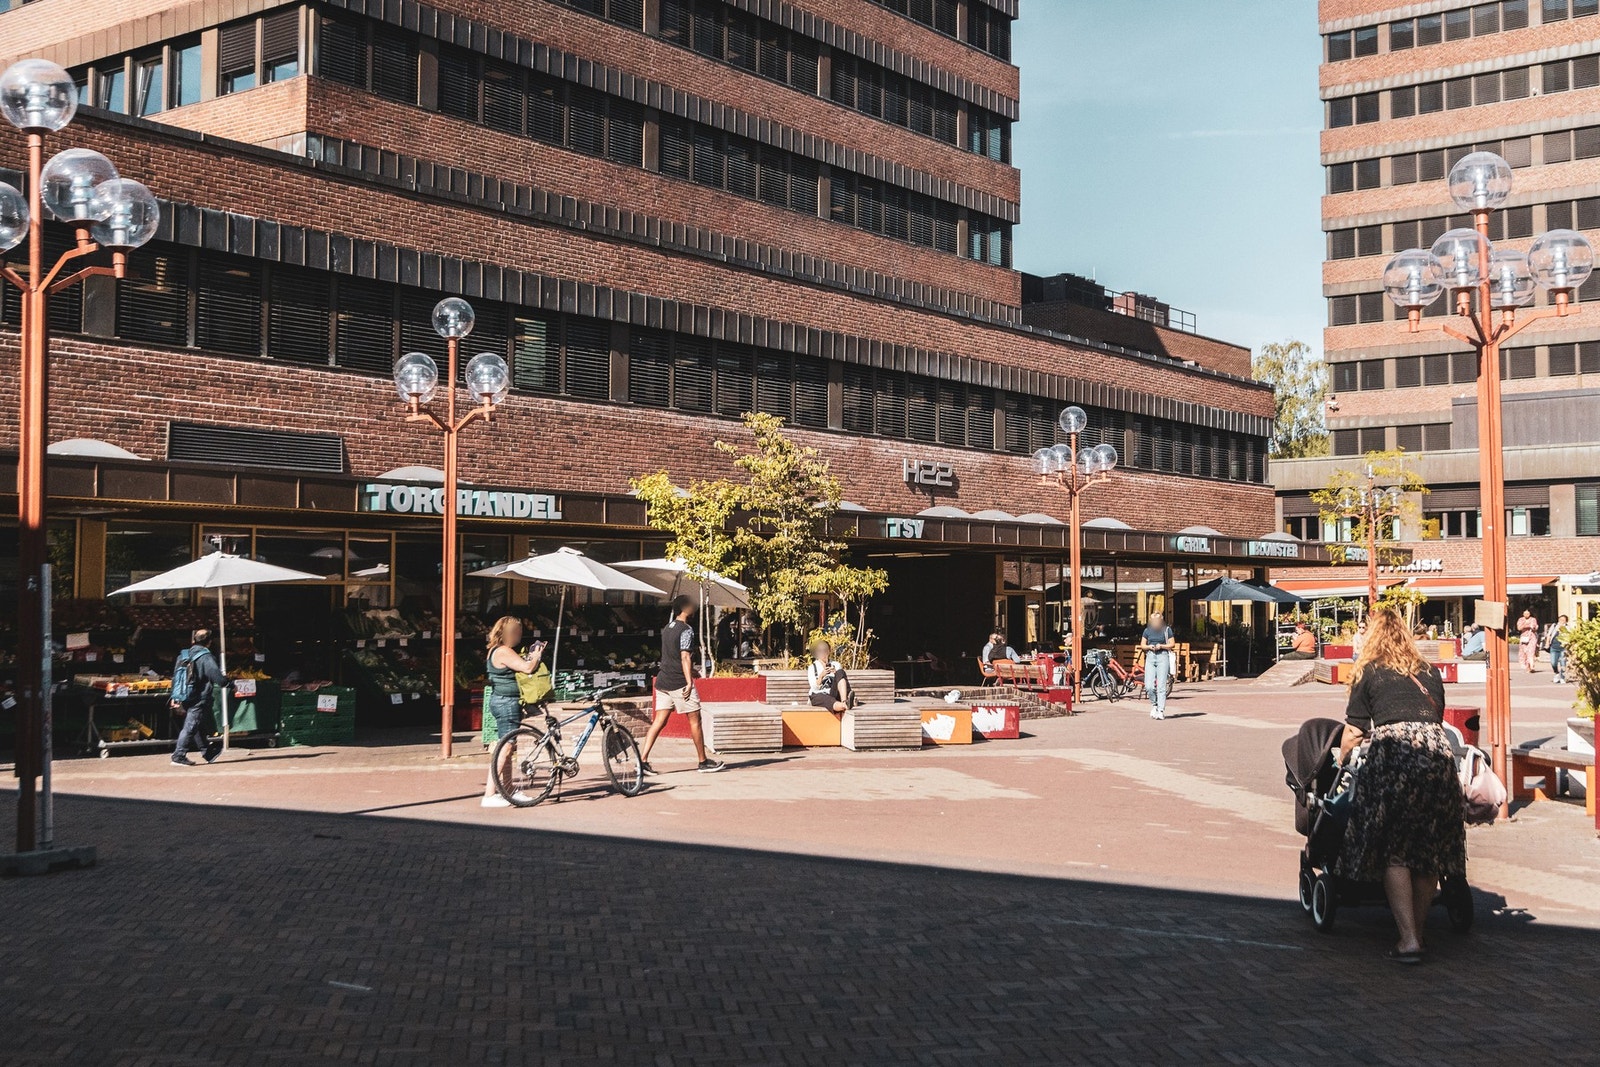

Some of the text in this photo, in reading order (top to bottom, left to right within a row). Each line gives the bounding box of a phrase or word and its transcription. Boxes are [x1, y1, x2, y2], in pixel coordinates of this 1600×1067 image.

[903, 458, 953, 486] H22
[886, 518, 925, 539] TSV
[1178, 536, 1211, 552] GRILL
[1249, 541, 1299, 557] BLOMSTER
[1379, 559, 1443, 571] KISK
